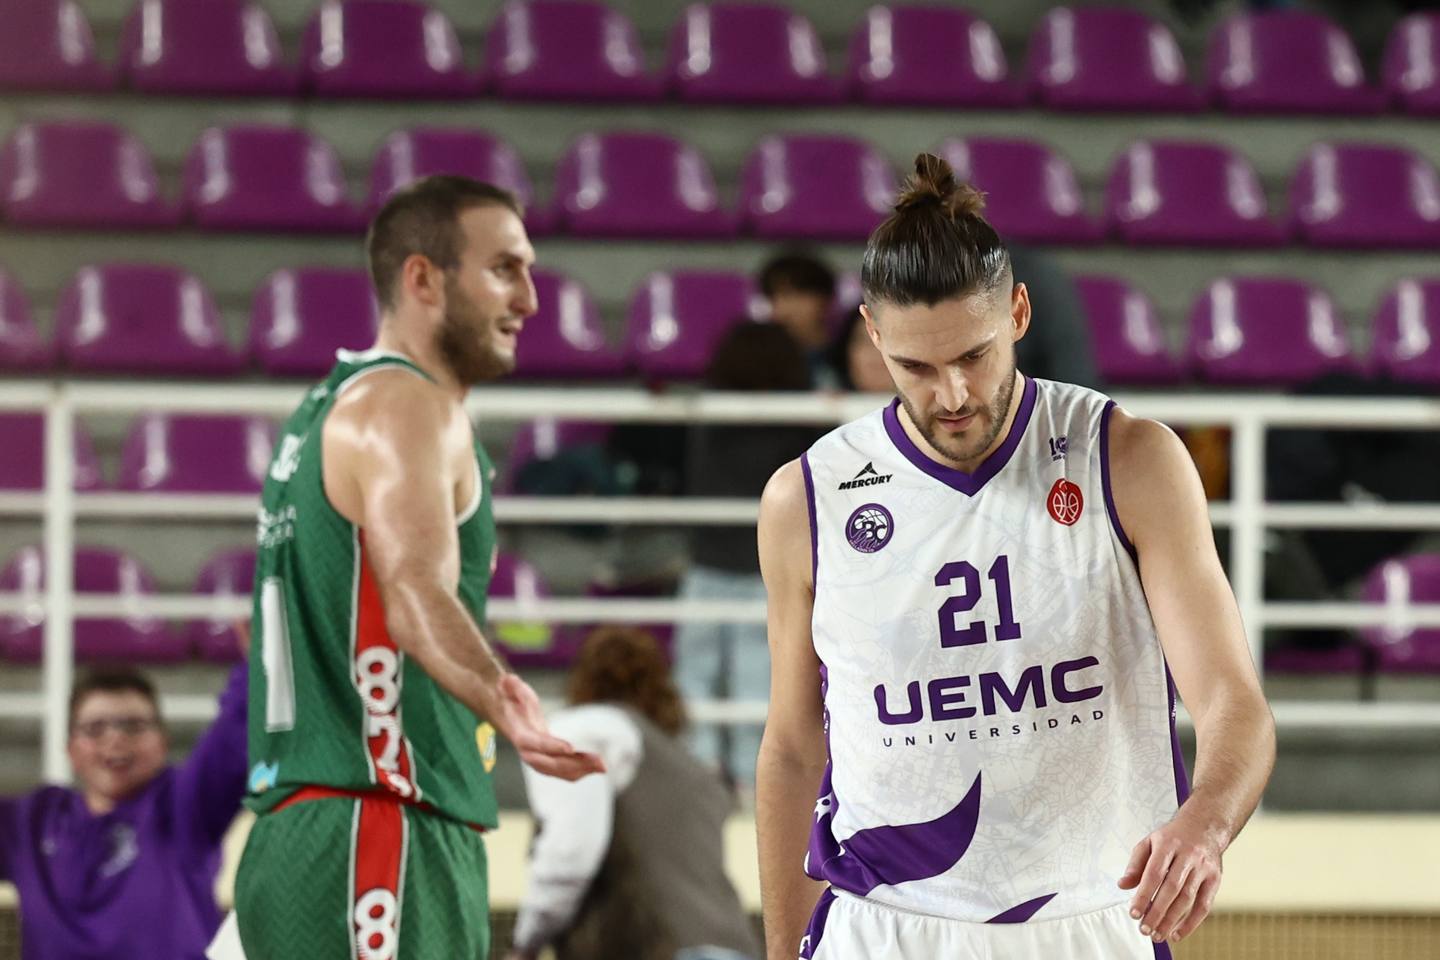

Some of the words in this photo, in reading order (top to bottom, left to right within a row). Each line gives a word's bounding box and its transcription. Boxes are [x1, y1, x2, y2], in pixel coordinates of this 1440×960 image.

[838, 474, 893, 491] MERCURY
[934, 554, 1021, 648] 21
[873, 655, 1104, 725] UEMC
[882, 710, 1104, 747] UNIVERSIDAD
